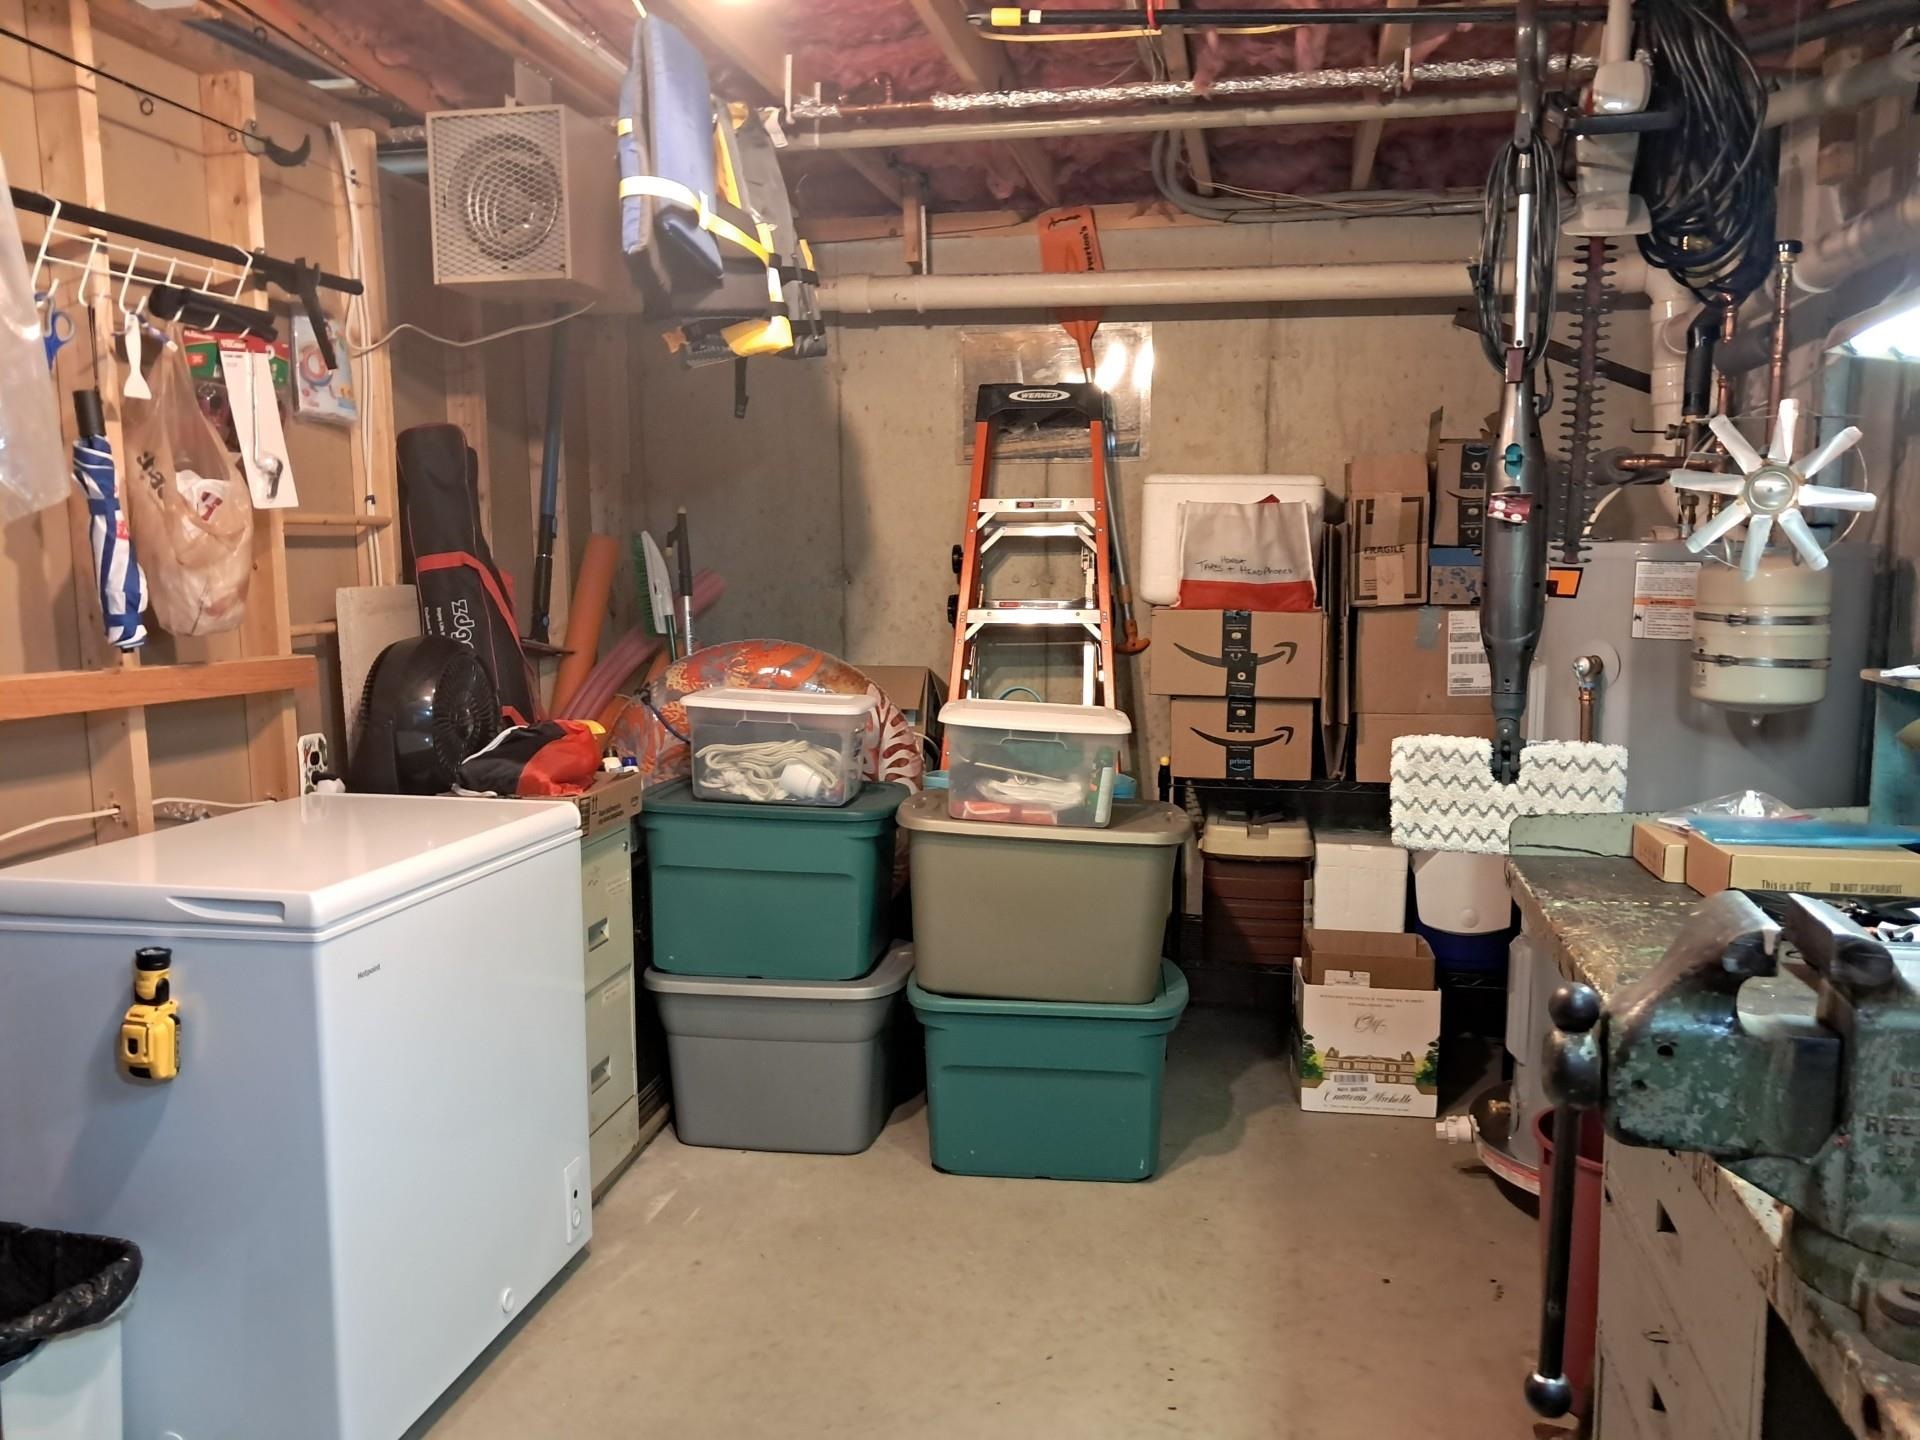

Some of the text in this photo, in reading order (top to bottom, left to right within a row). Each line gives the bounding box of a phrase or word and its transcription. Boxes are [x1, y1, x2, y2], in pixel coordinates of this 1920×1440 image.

[1020, 391, 1059, 399] WERNER
[1364, 544, 1405, 554] FRAGILE
[1229, 758, 1251, 766] prime
[1761, 879, 1778, 890] This
[358, 963, 380, 979] Hotpoint
